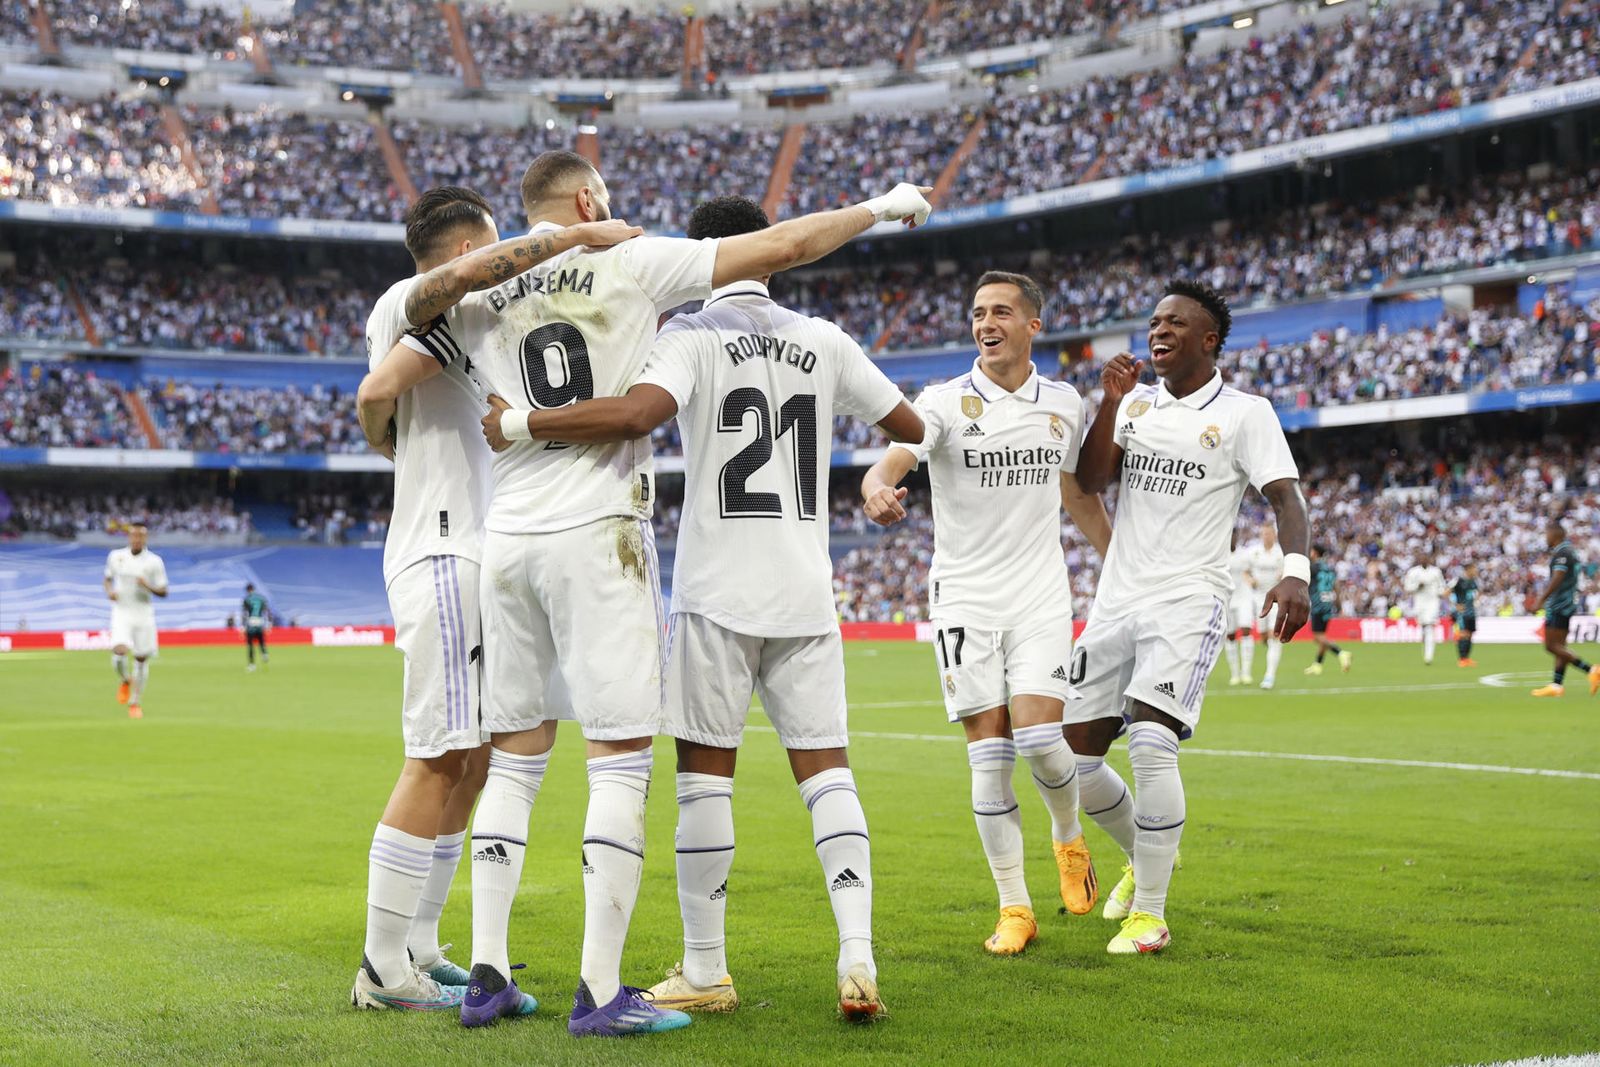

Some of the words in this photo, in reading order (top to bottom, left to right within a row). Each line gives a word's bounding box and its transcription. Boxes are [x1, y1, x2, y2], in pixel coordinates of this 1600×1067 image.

[487, 268, 595, 314] BENZEMA
[724, 334, 817, 374] RODRYGO
[519, 322, 594, 449] 9
[717, 387, 817, 521] 21
[963, 446, 1062, 468] Emirates
[1123, 448, 1207, 480] Emirates
[981, 471, 1002, 488] FLY
[1007, 468, 1050, 486] BETTER
[1127, 472, 1142, 489] FLY
[1144, 474, 1188, 497] BETTER
[937, 627, 965, 668] 17
[473, 854, 511, 866] adidas
[830, 879, 865, 892] adidas
